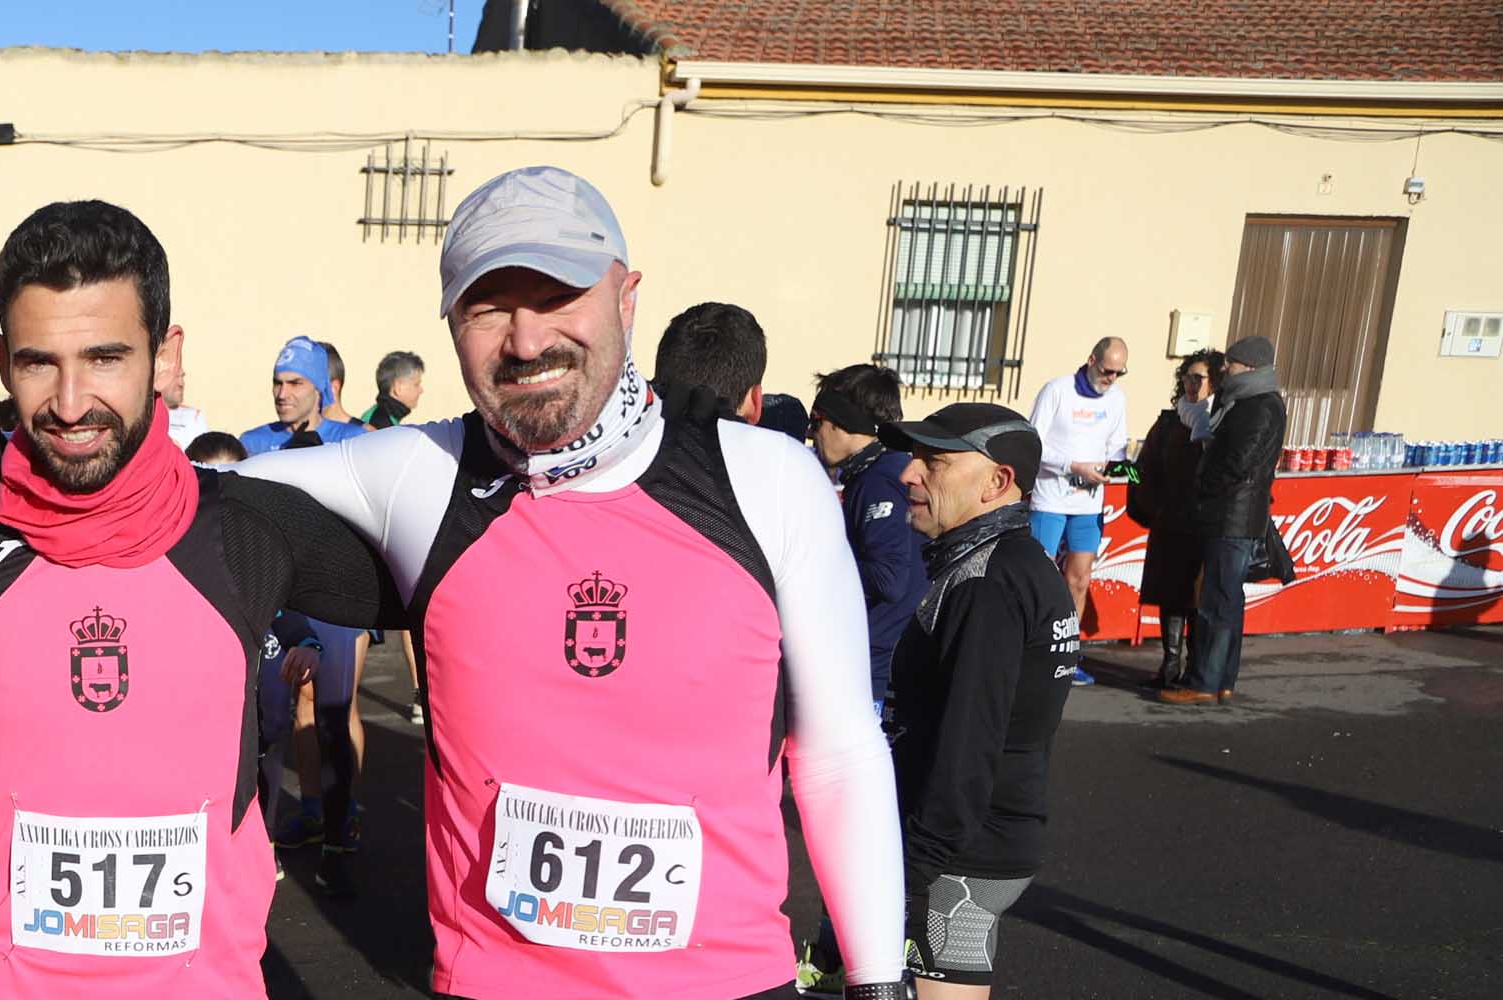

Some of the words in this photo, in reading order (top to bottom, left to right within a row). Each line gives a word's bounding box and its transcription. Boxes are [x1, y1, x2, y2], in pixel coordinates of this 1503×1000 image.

[53, 827, 80, 848] LIGA
[83, 829, 122, 849] CROSS
[125, 825, 199, 848] CABRERIZOS
[538, 806, 566, 830] LIGA
[569, 809, 610, 835] CROSS
[613, 816, 694, 841] CABRERIZOS
[50, 852, 167, 909] 517
[530, 831, 655, 904] 612
[173, 872, 193, 897] S
[23, 908, 191, 940] JOMISAGA
[498, 890, 678, 936] JOMISAGA
[104, 938, 187, 952] REFORMAS
[579, 934, 672, 948] REFORMAS
